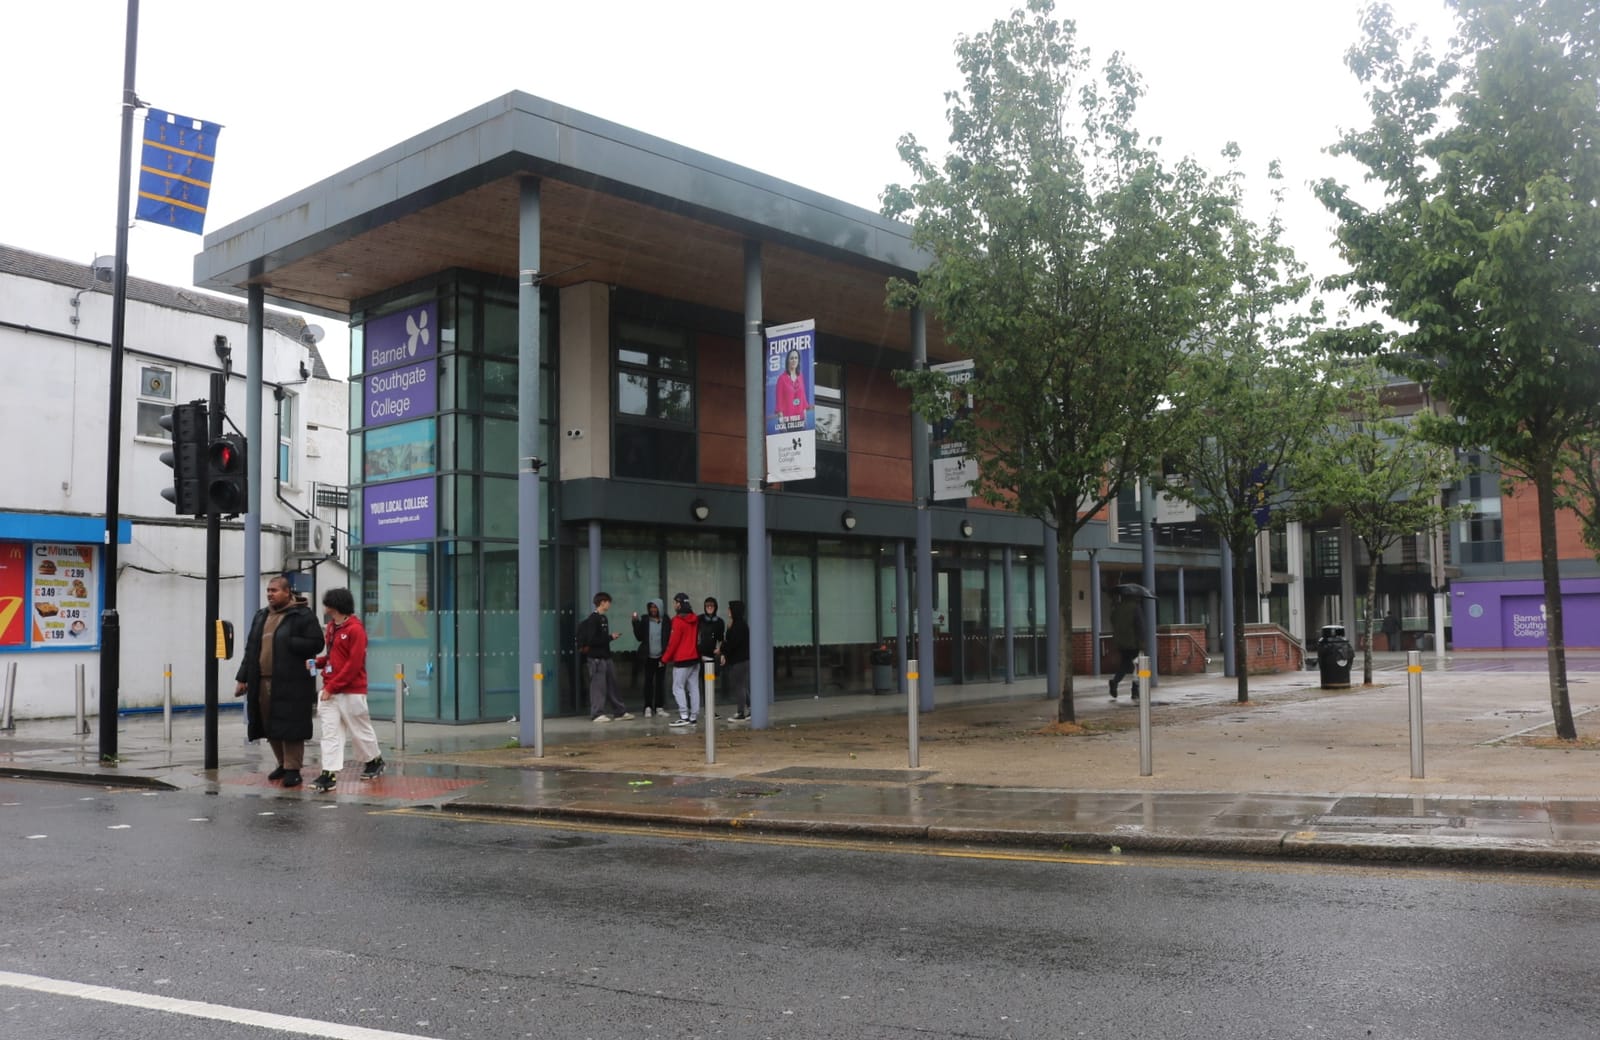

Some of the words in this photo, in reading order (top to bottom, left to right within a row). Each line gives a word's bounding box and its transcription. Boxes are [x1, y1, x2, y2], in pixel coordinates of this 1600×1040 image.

[371, 342, 407, 367] Barnet
[770, 335, 811, 355] FURTHER
[371, 367, 427, 394] Southgate
[371, 397, 410, 418] College
[370, 502, 385, 515] YOUR
[385, 499, 403, 513] LOCAL
[403, 495, 429, 511] COLLEGE
[1513, 614, 1541, 622] Barnet
[1513, 629, 1545, 638] College
